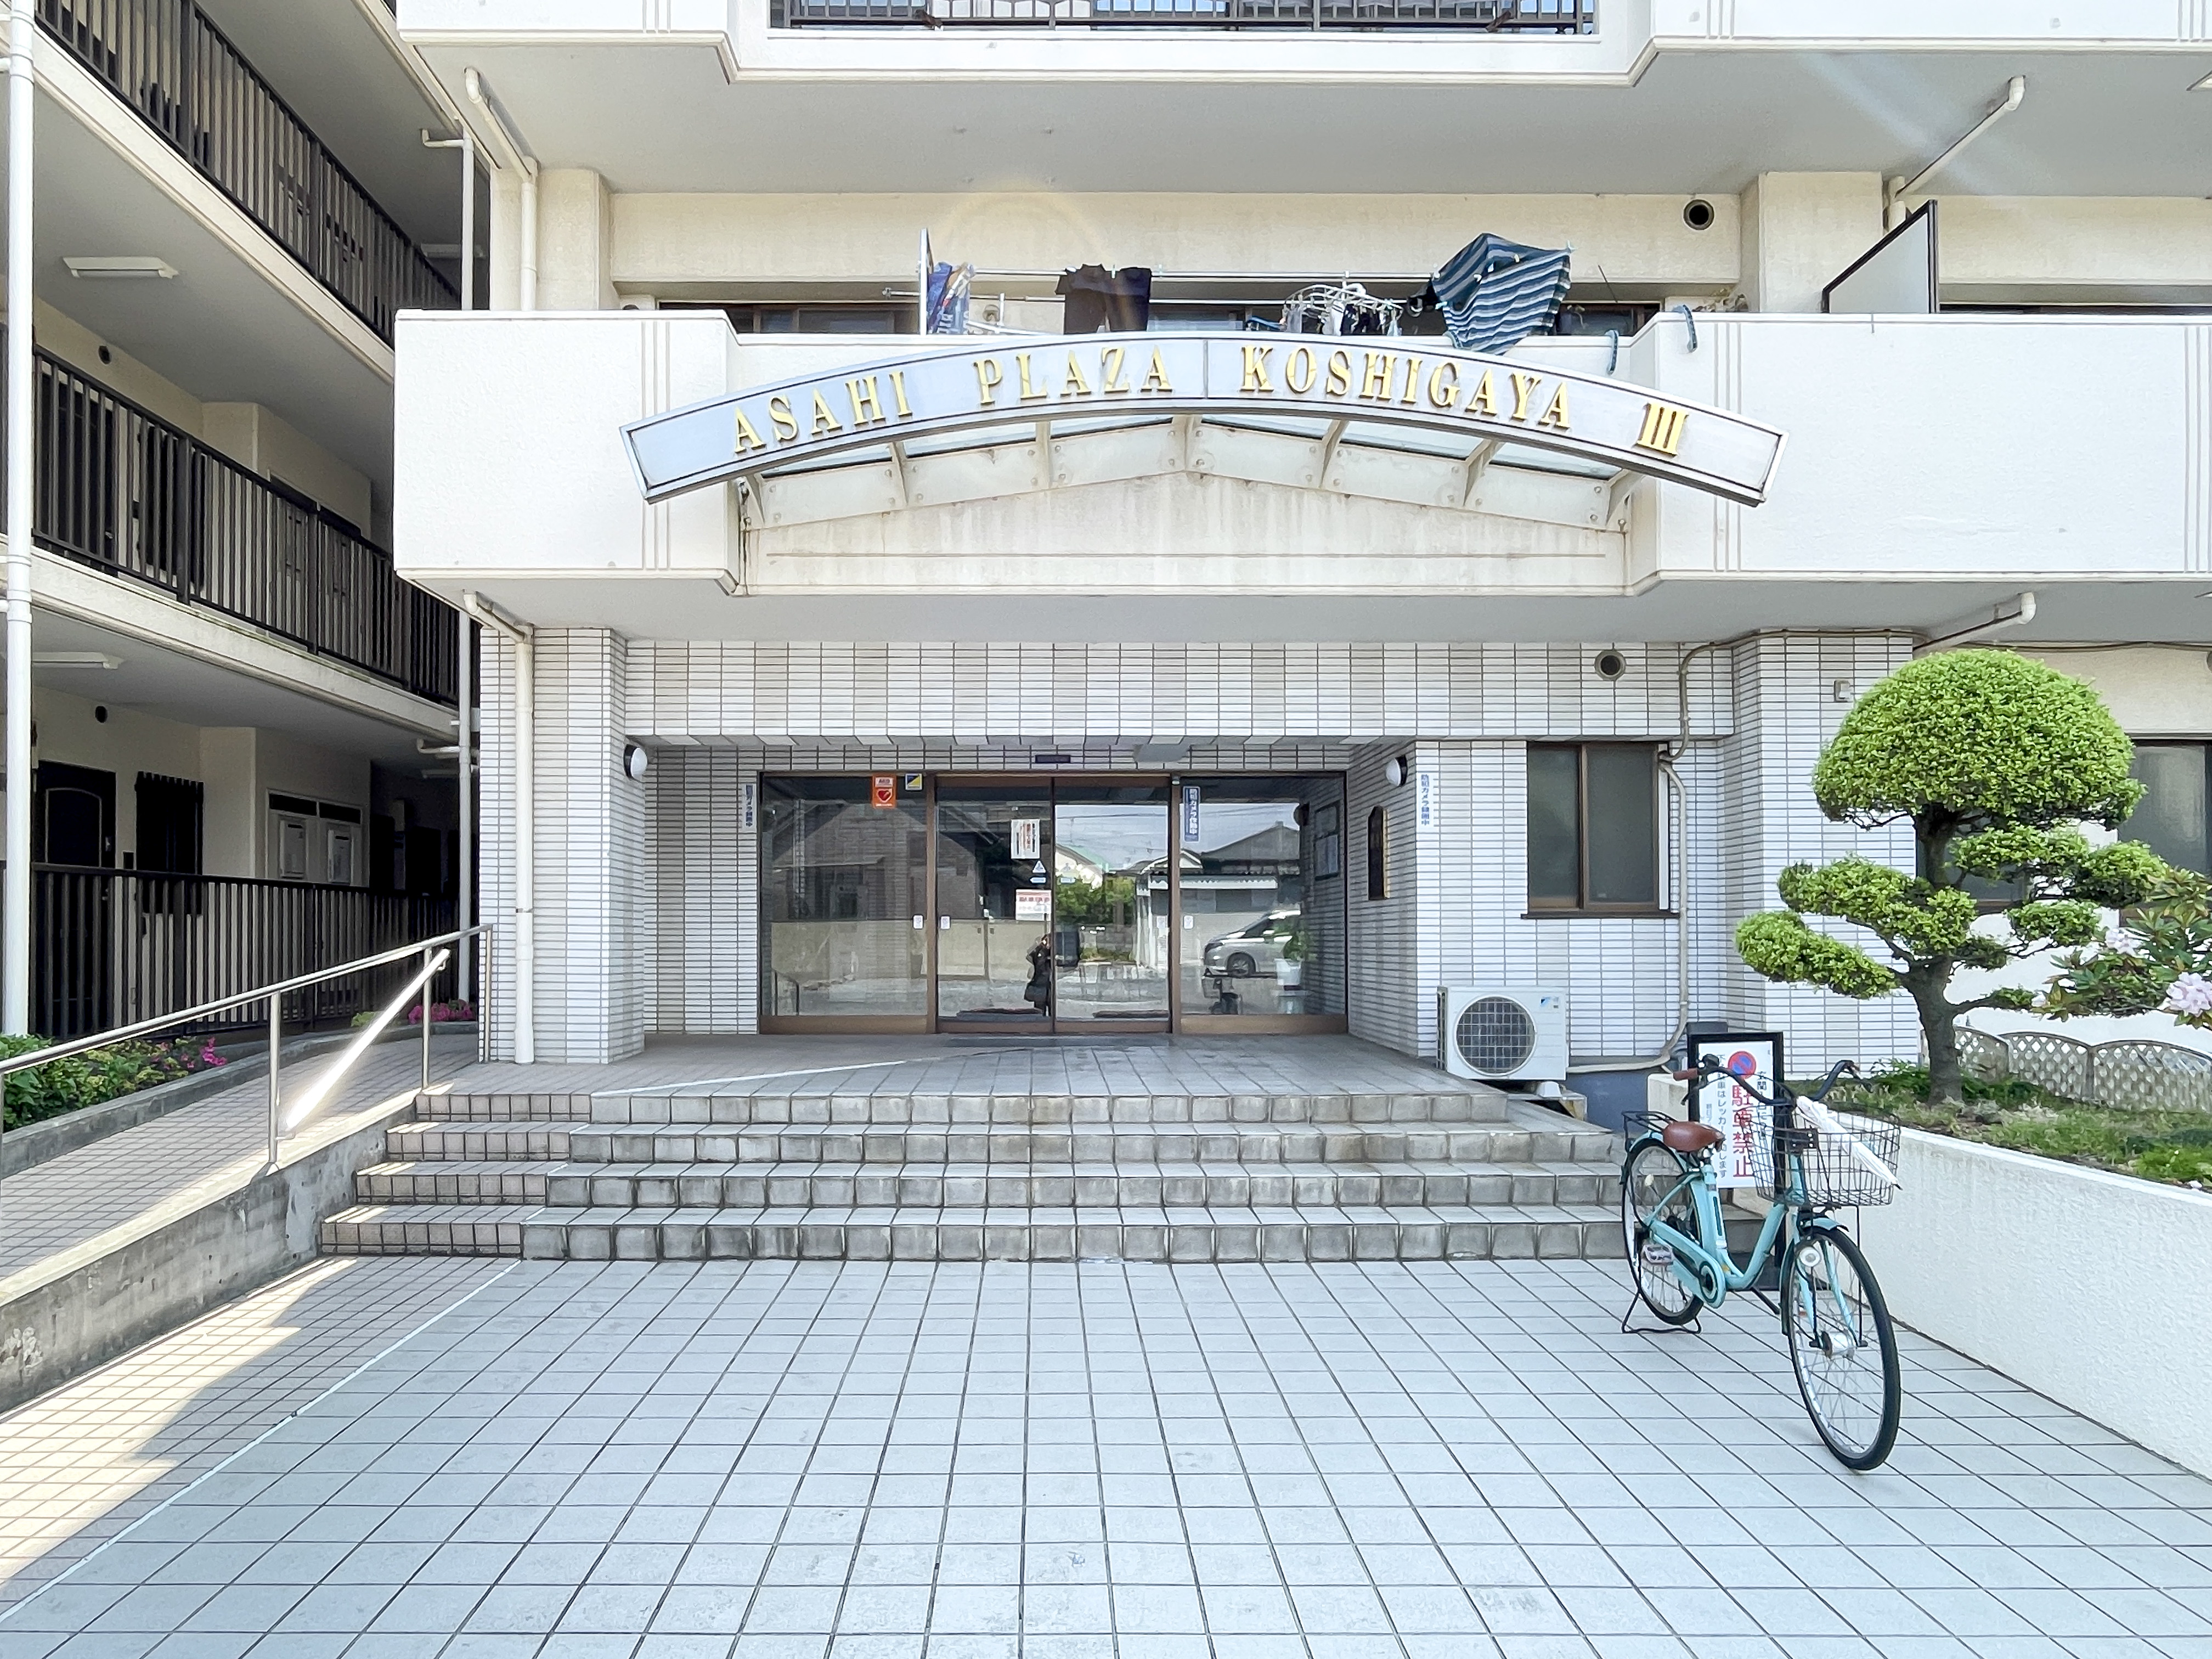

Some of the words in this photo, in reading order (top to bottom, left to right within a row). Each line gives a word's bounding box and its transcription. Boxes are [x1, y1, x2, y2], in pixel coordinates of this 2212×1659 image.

[733, 371, 913, 453] ASAHI
[973, 345, 1175, 406] PLAZA
[1239, 345, 1571, 430] KOSHIGAYA
[1731, 1084, 1756, 1177] 駐車禁止
